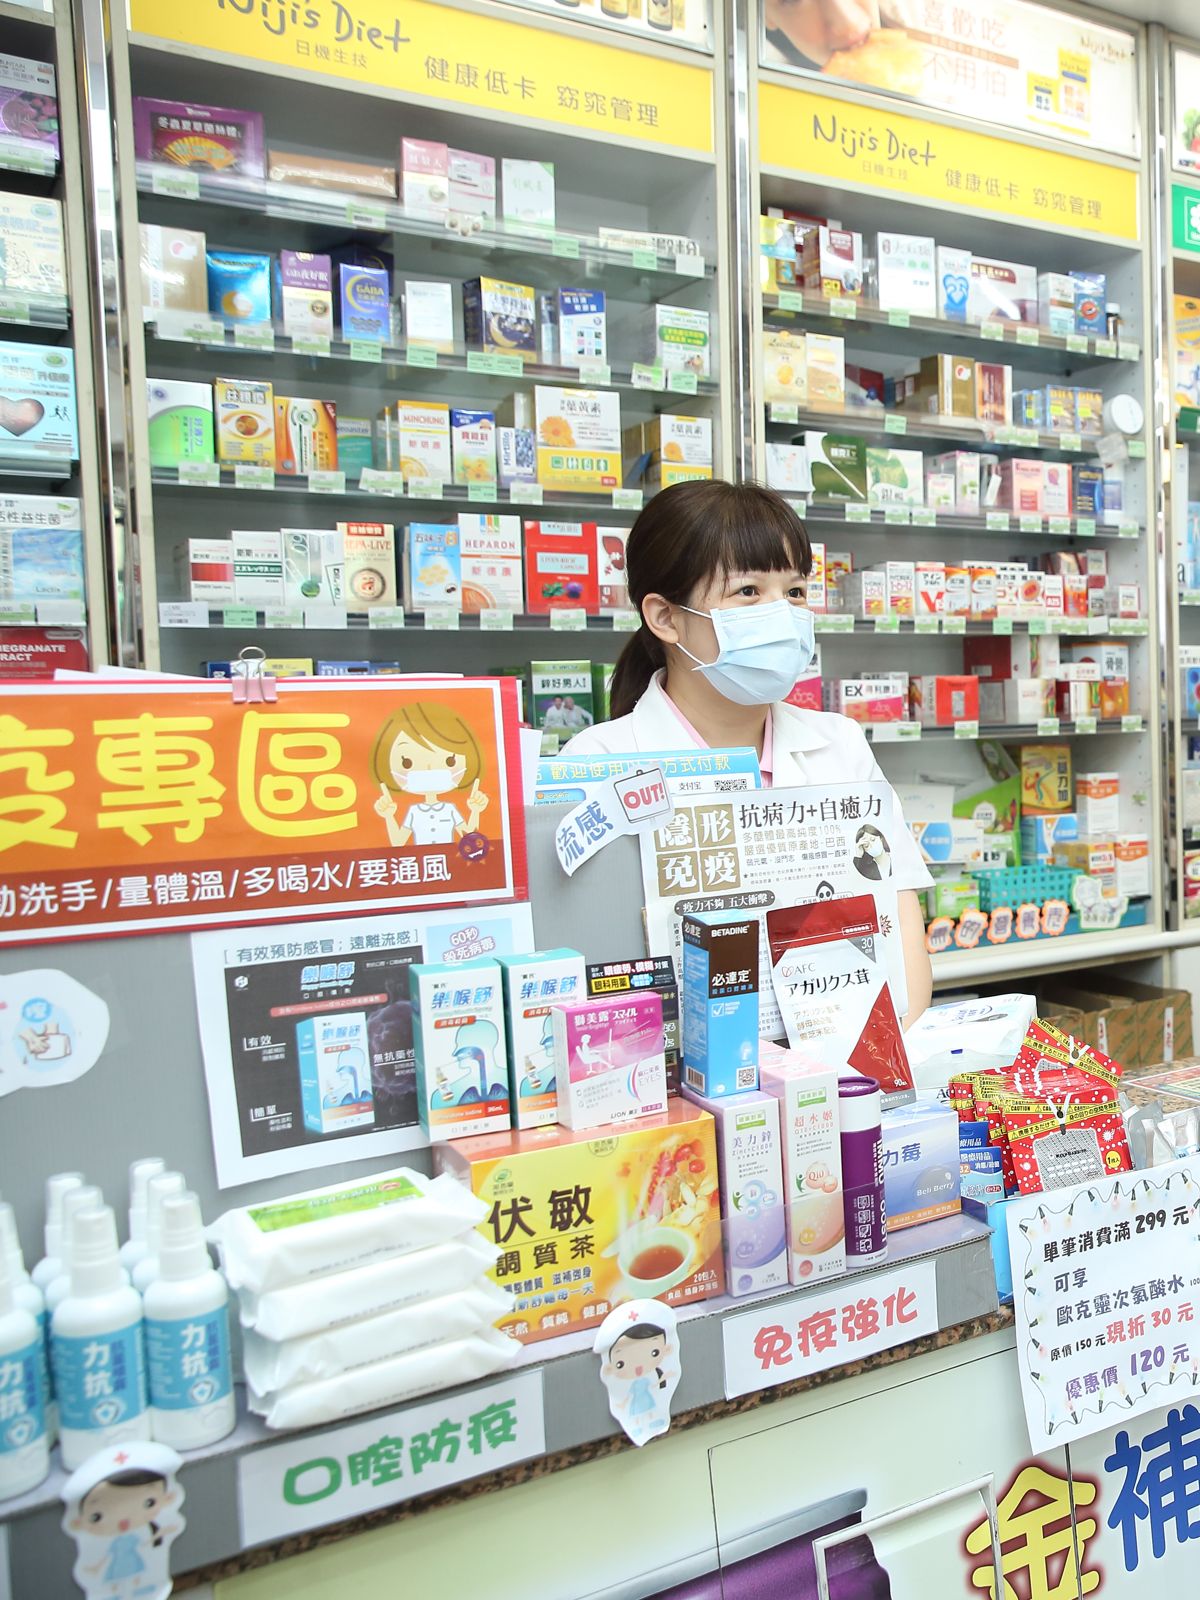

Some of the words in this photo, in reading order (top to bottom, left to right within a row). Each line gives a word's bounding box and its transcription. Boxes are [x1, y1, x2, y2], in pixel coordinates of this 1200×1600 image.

[332, 1, 411, 52] Diet
[296, 39, 368, 69] 日機生技
[424, 54, 538, 101] 健康低卡
[555, 84, 660, 128] 窈窕管理
[811, 113, 879, 159] Niji's
[885, 128, 937, 167] Diet
[944, 168, 1021, 202] 健康低卡
[1032, 187, 1104, 220] 窈窕管理
[464, 539, 517, 550] HEPARON
[623, 782, 666, 810] OUT!
[738, 794, 882, 829] 抗病力+自癒力
[557, 800, 615, 868] 流感
[659, 808, 731, 848] 隱形
[661, 852, 738, 893] 免疫
[449, 926, 480, 947] 60秒
[711, 926, 749, 938] BETADINE
[520, 974, 578, 1000] 樂喉舒
[711, 969, 750, 987] 必達定
[785, 967, 871, 997] アガリクス茸
[794, 962, 816, 975] AFC
[431, 986, 493, 1009] 樂喉舒
[1038, 1019, 1056, 1034] CAUTION
[610, 1111, 627, 1120] LION
[933, 1182, 955, 1193] Berry
[488, 1184, 595, 1245] 伏敏
[1043, 1220, 1131, 1264] 單筆消費滿
[1134, 1208, 1167, 1235] 299
[1172, 1205, 1190, 1228] 元
[496, 1234, 595, 1278] 調質茶
[513, 1283, 596, 1313] 新舒暢每一天
[1053, 1267, 1088, 1294] 可享
[500, 1323, 530, 1339] 天然
[582, 1301, 610, 1319] 健康
[1056, 1273, 1185, 1328] 歐克靈次氯酸水
[753, 1286, 919, 1370] 免疫強化
[1050, 1343, 1072, 1362] 原價
[1075, 1337, 1092, 1352] 150
[1151, 1306, 1172, 1329] 30
[1177, 1301, 1195, 1323] 元
[82, 1341, 113, 1399] 力抗
[180, 1323, 209, 1379] 力抗
[1065, 1365, 1119, 1401] 優惠價
[1130, 1347, 1165, 1377] 120
[1172, 1343, 1190, 1365] 元
[282, 1397, 518, 1508] 口腔防疫
